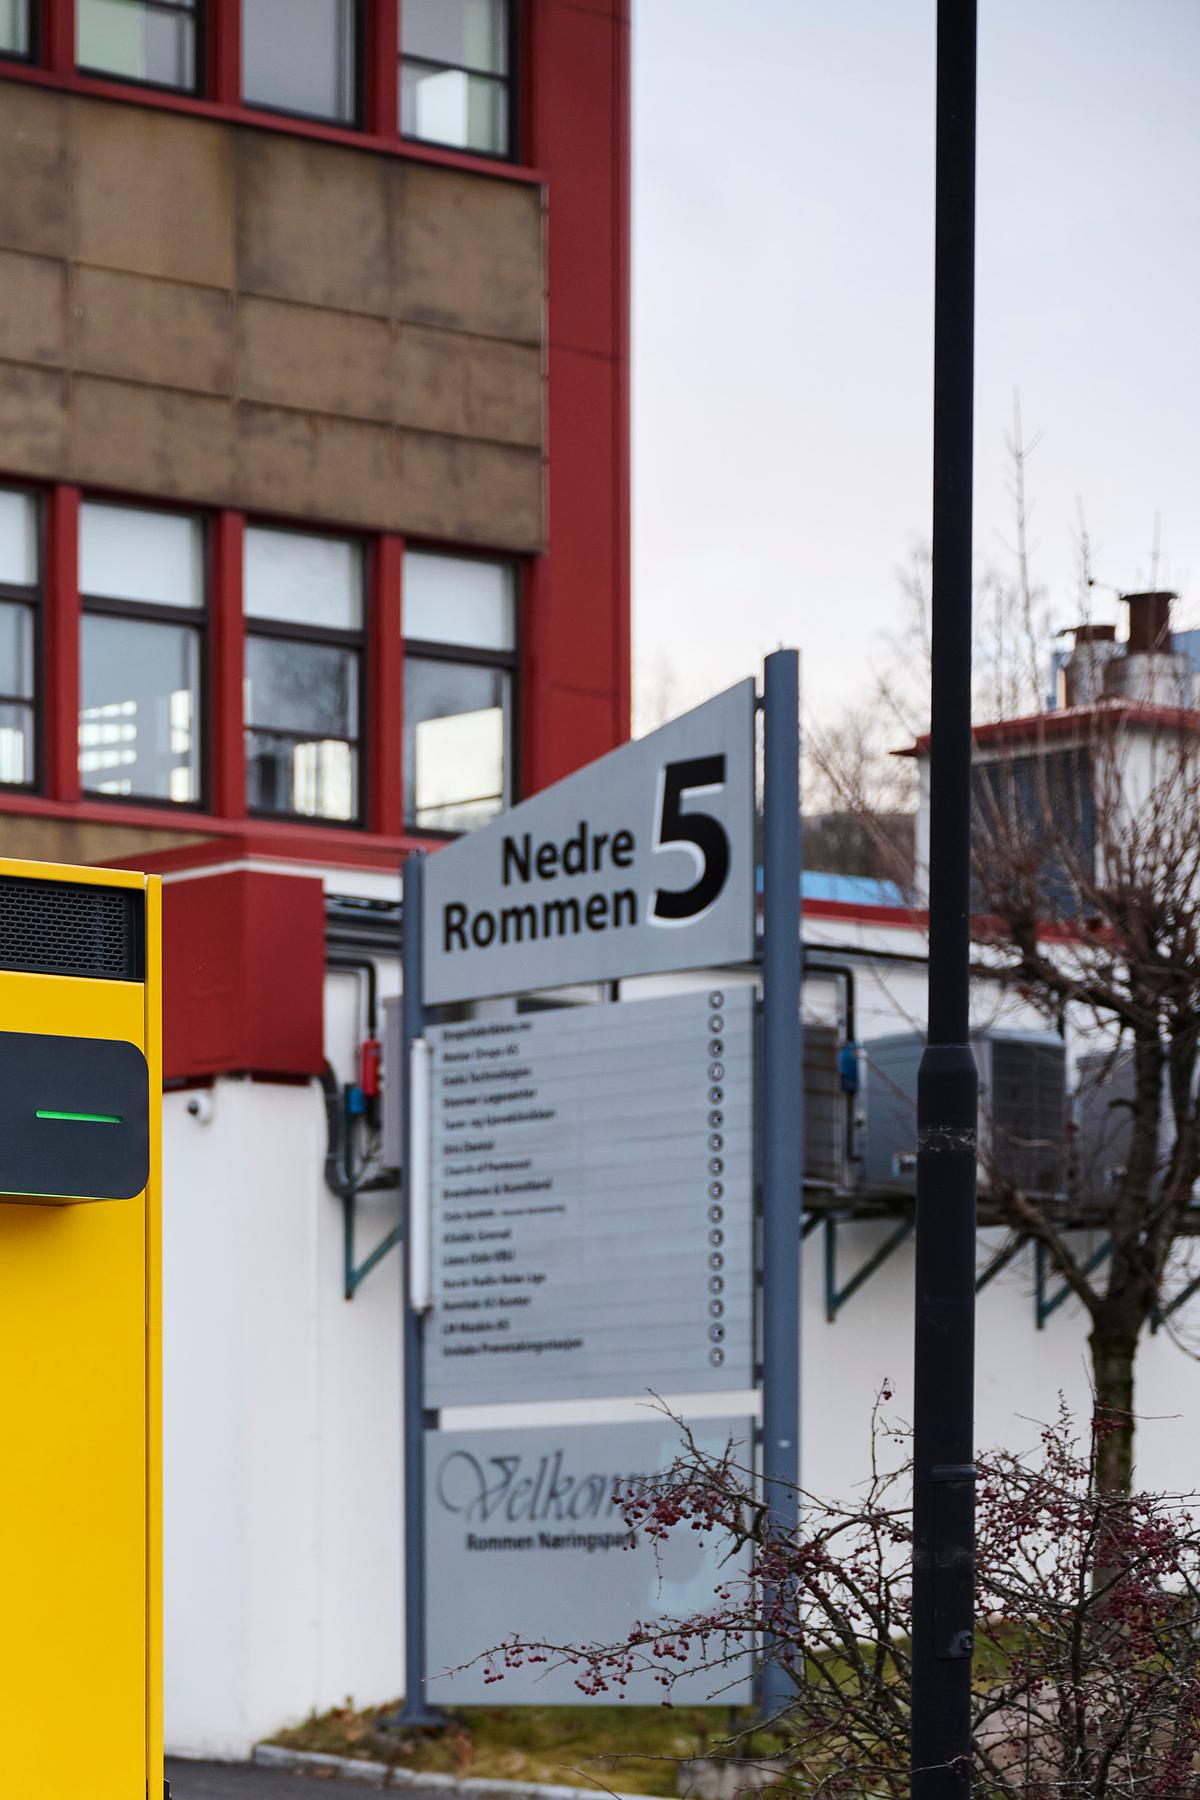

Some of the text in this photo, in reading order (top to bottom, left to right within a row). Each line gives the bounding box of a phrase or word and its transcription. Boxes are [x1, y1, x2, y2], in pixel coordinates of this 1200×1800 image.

[501, 820, 636, 887] Nedre
[648, 752, 731, 928] 5
[443, 889, 638, 953] Rommen
[467, 1534, 533, 1551] Rommen
